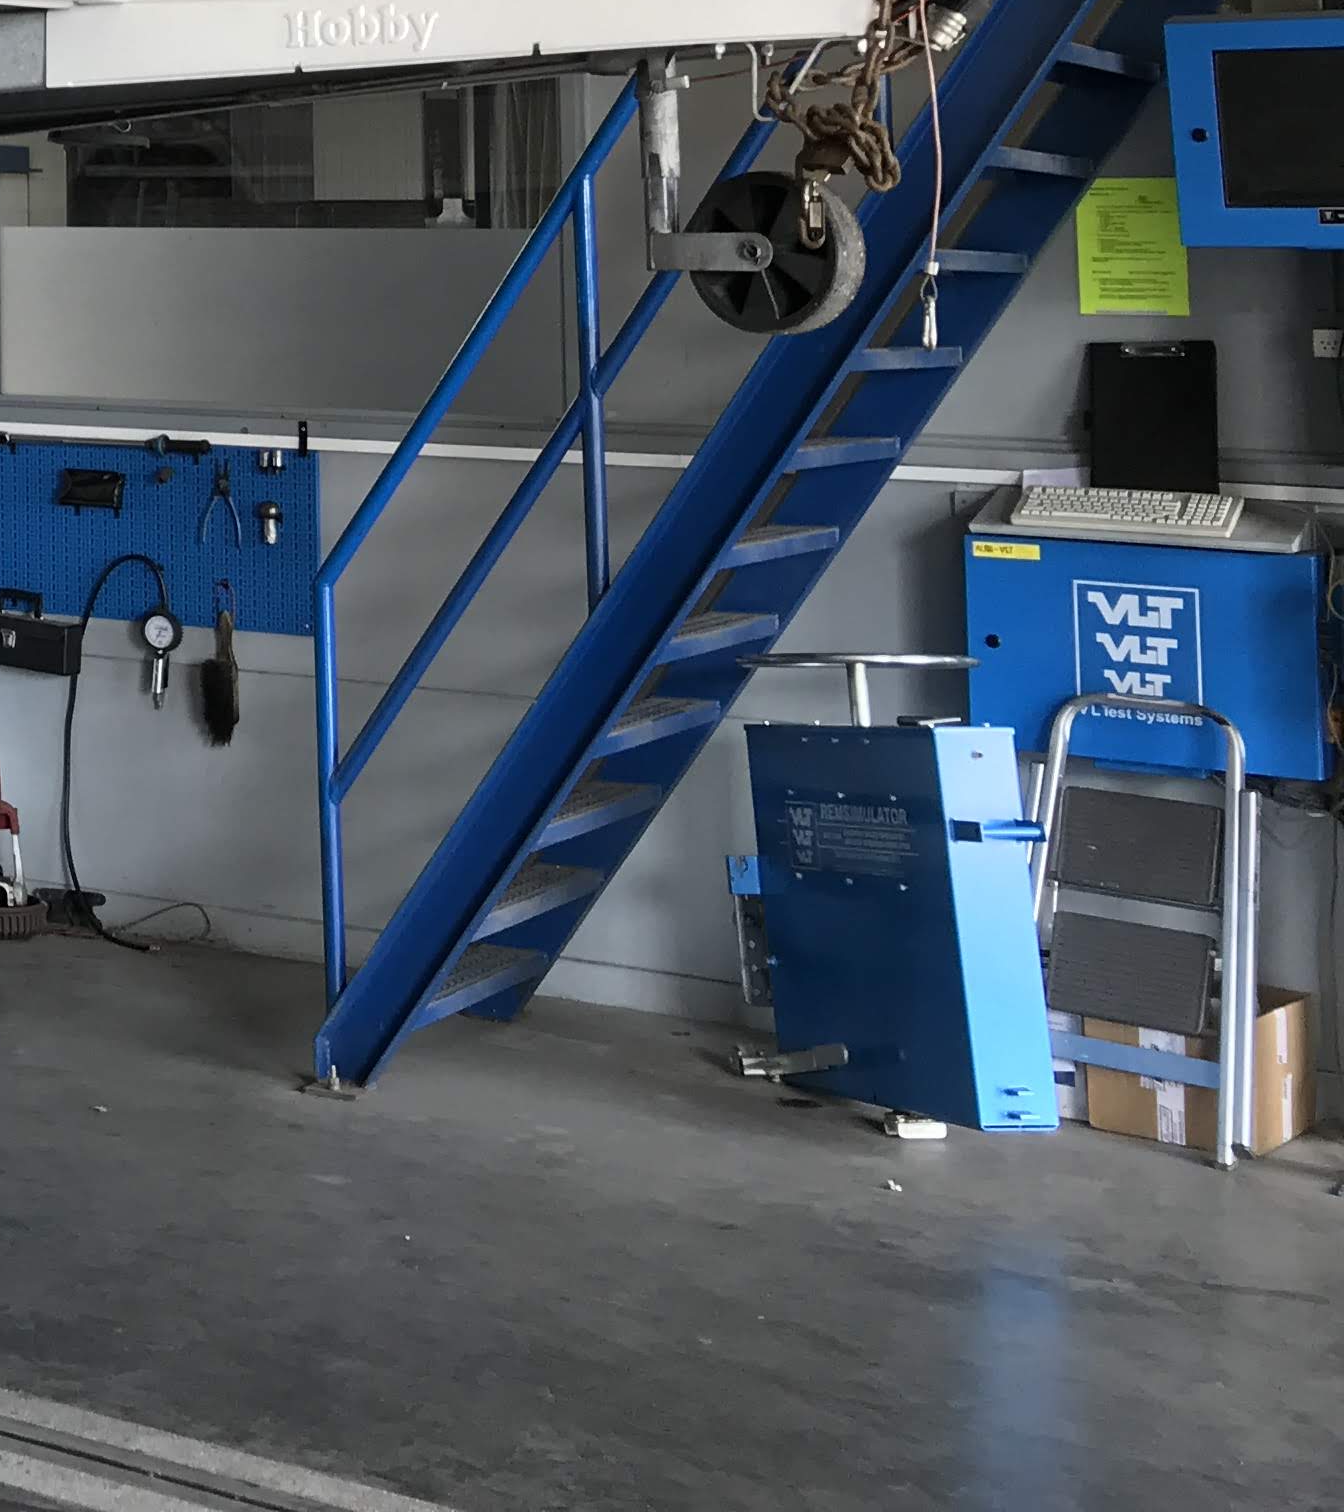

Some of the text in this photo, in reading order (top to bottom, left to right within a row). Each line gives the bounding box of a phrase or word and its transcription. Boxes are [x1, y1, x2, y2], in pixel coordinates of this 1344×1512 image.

[284, 2, 439, 52] Hobby
[1087, 591, 1184, 629] VLT
[1095, 632, 1178, 666] VLT
[1103, 669, 1172, 697] VLT
